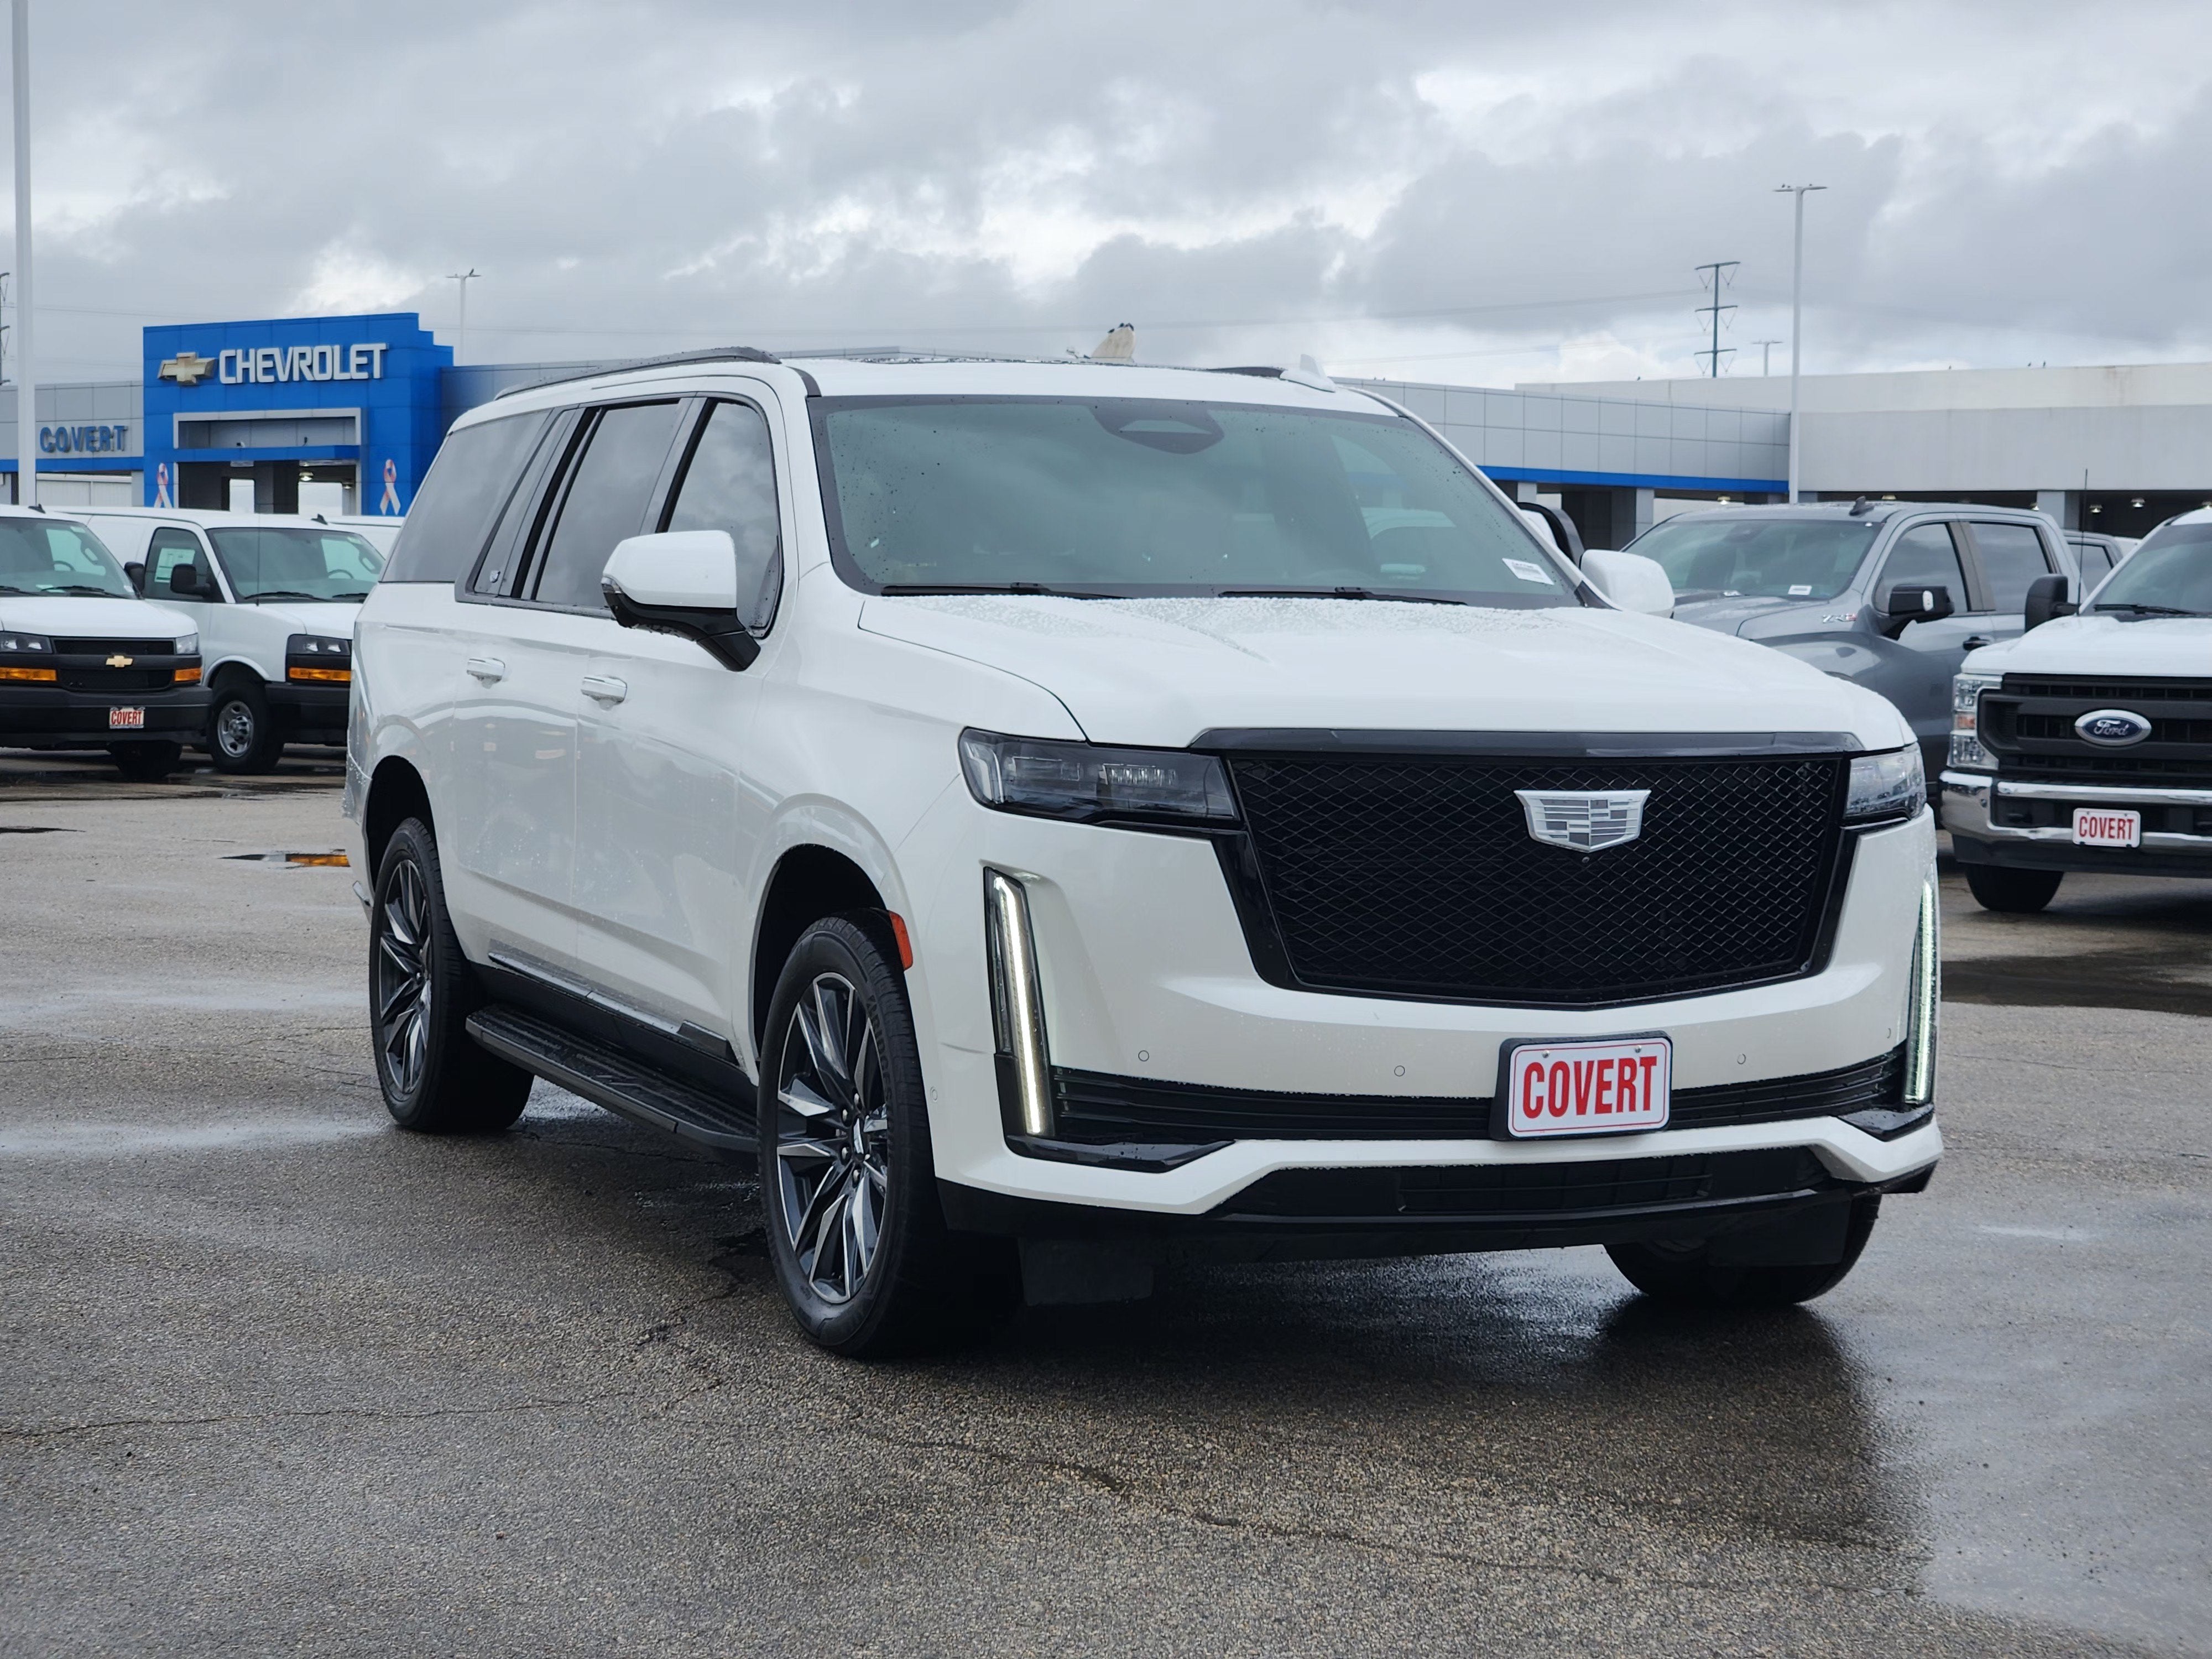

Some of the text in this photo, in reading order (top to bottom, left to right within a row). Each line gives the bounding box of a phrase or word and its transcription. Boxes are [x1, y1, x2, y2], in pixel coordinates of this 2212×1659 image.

[220, 343, 387, 384] CHEVROLET
[40, 425, 126, 453] COVERT
[111, 711, 142, 724] COVERT
[2094, 719, 2130, 735] Ford
[2079, 816, 2134, 839] COVERT
[1522, 1056, 1657, 1119] COVERT
